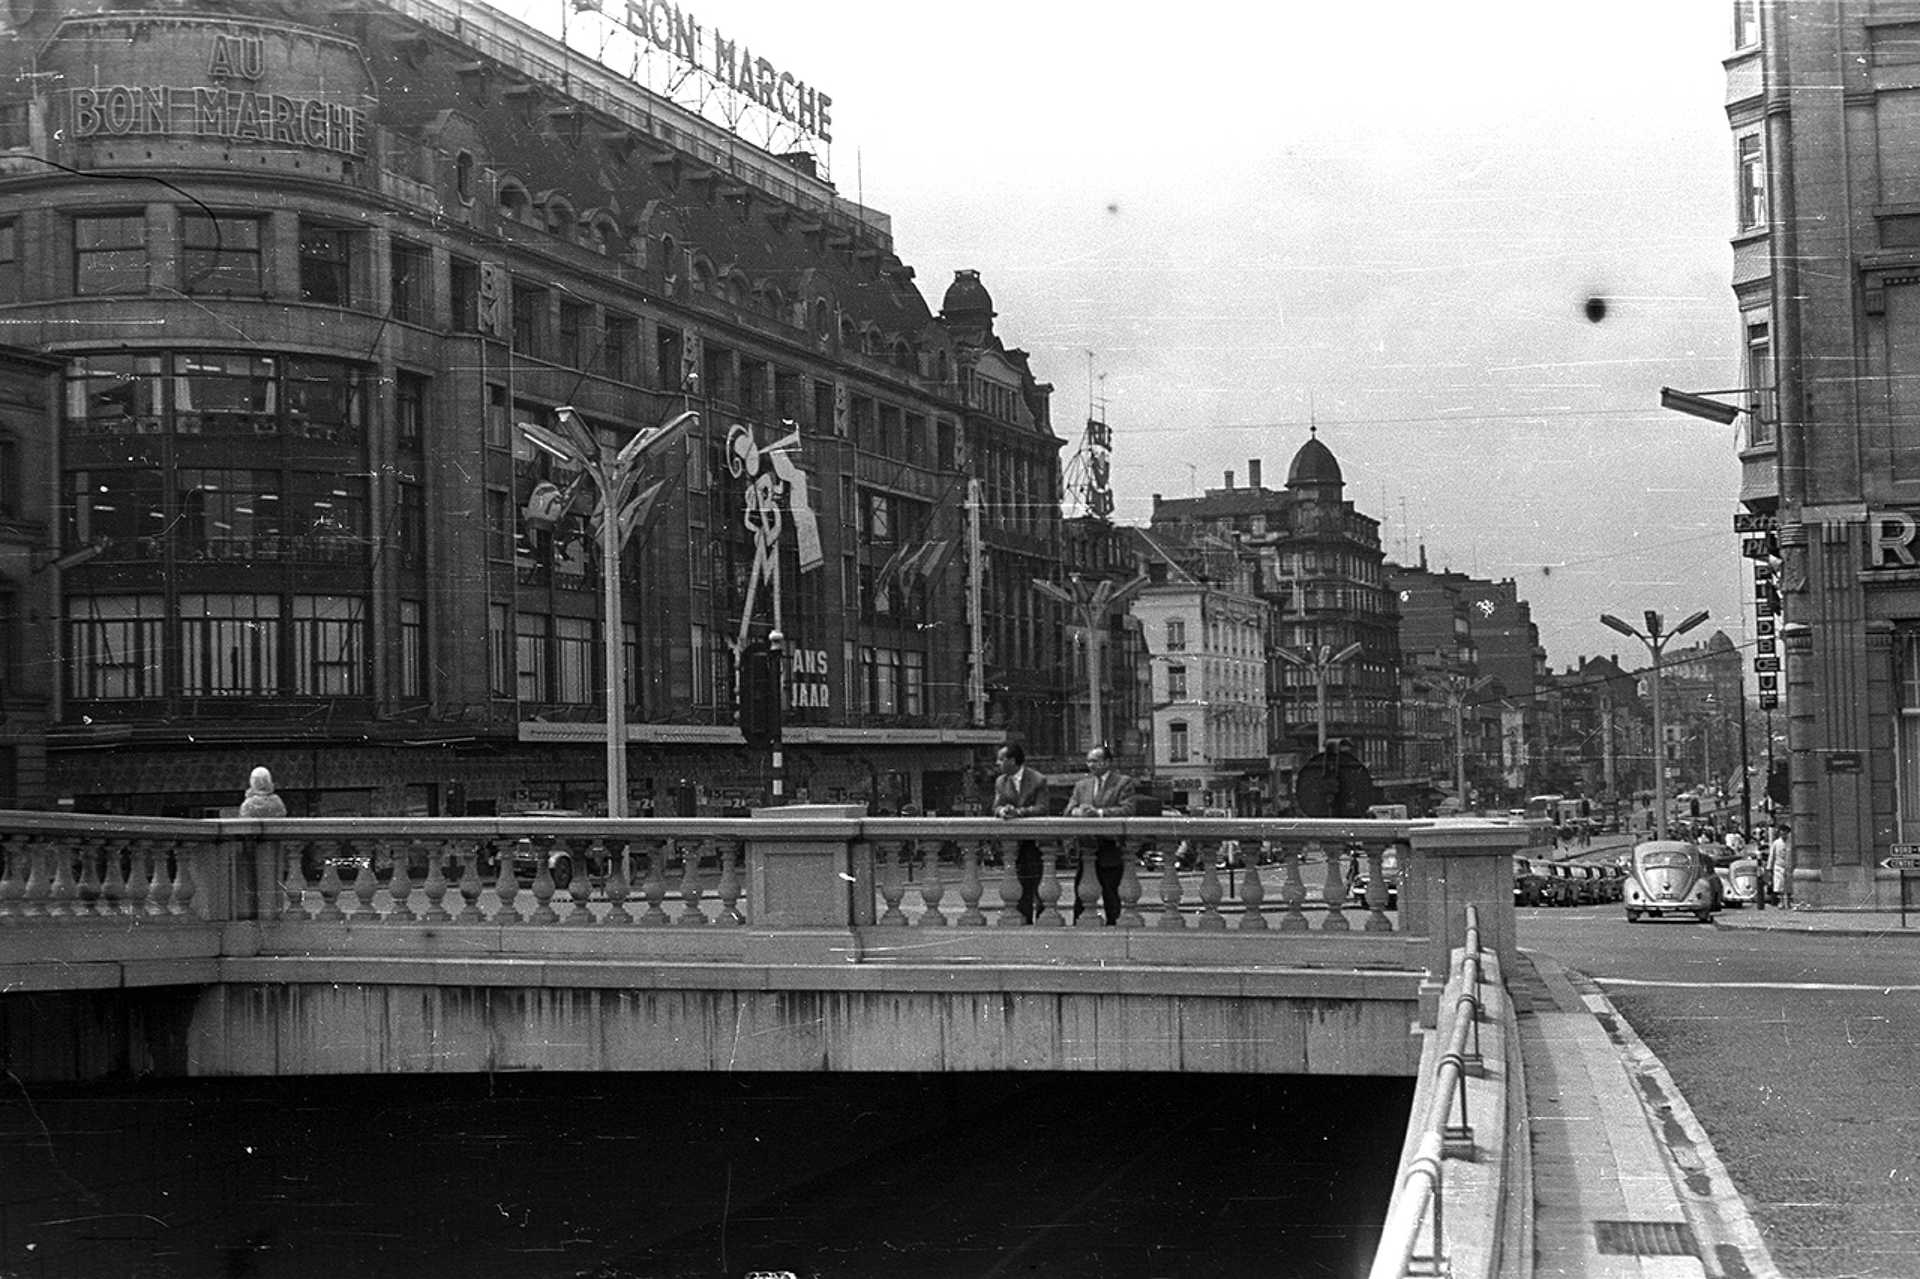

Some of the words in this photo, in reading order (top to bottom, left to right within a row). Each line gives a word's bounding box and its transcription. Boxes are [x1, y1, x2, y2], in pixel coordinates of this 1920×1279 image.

[207, 34, 265, 80] AU
[715, 27, 832, 144] MARCHE
[70, 85, 170, 137] BON
[193, 86, 369, 161] MARCHE
[792, 649, 828, 674] ANS
